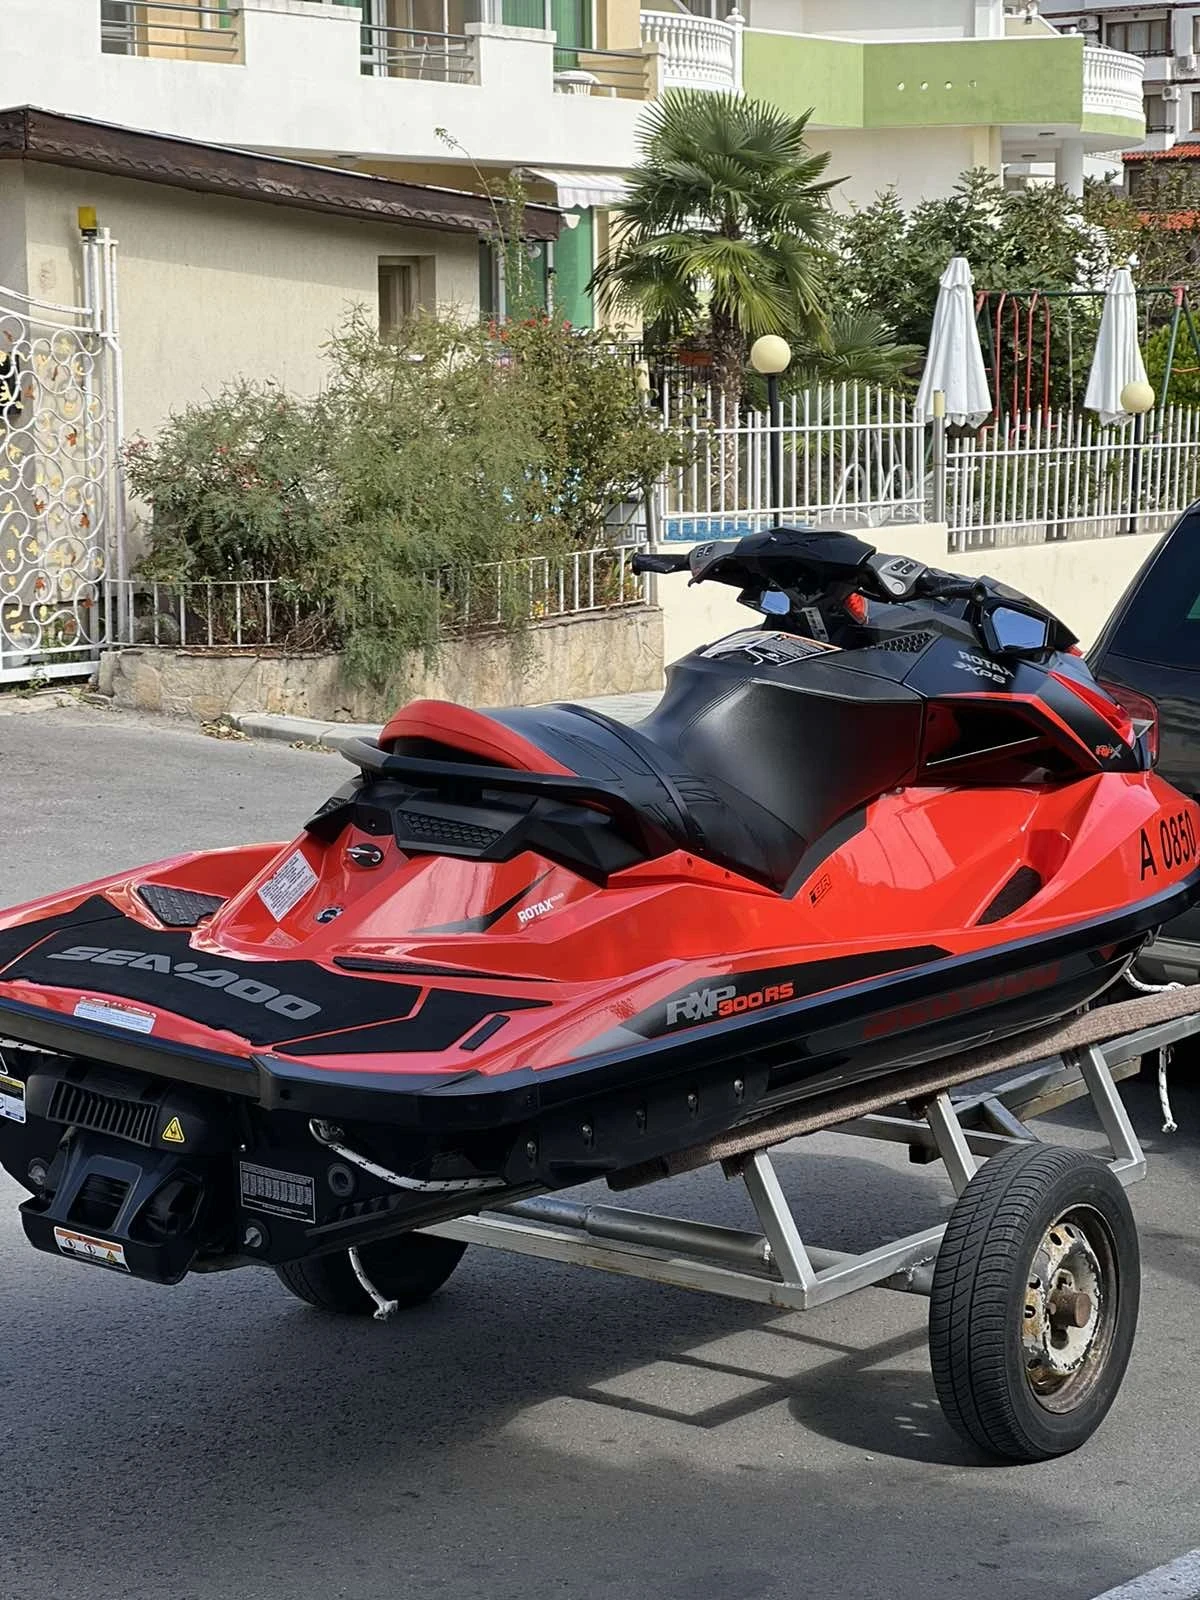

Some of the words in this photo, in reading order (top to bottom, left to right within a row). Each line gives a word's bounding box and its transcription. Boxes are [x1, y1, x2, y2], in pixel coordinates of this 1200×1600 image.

[963, 663, 1006, 684] XPS
[1140, 827, 1158, 881] A
[1160, 809, 1197, 870] 0850
[517, 898, 554, 923] ROTAX
[666, 985, 737, 1026] RXP
